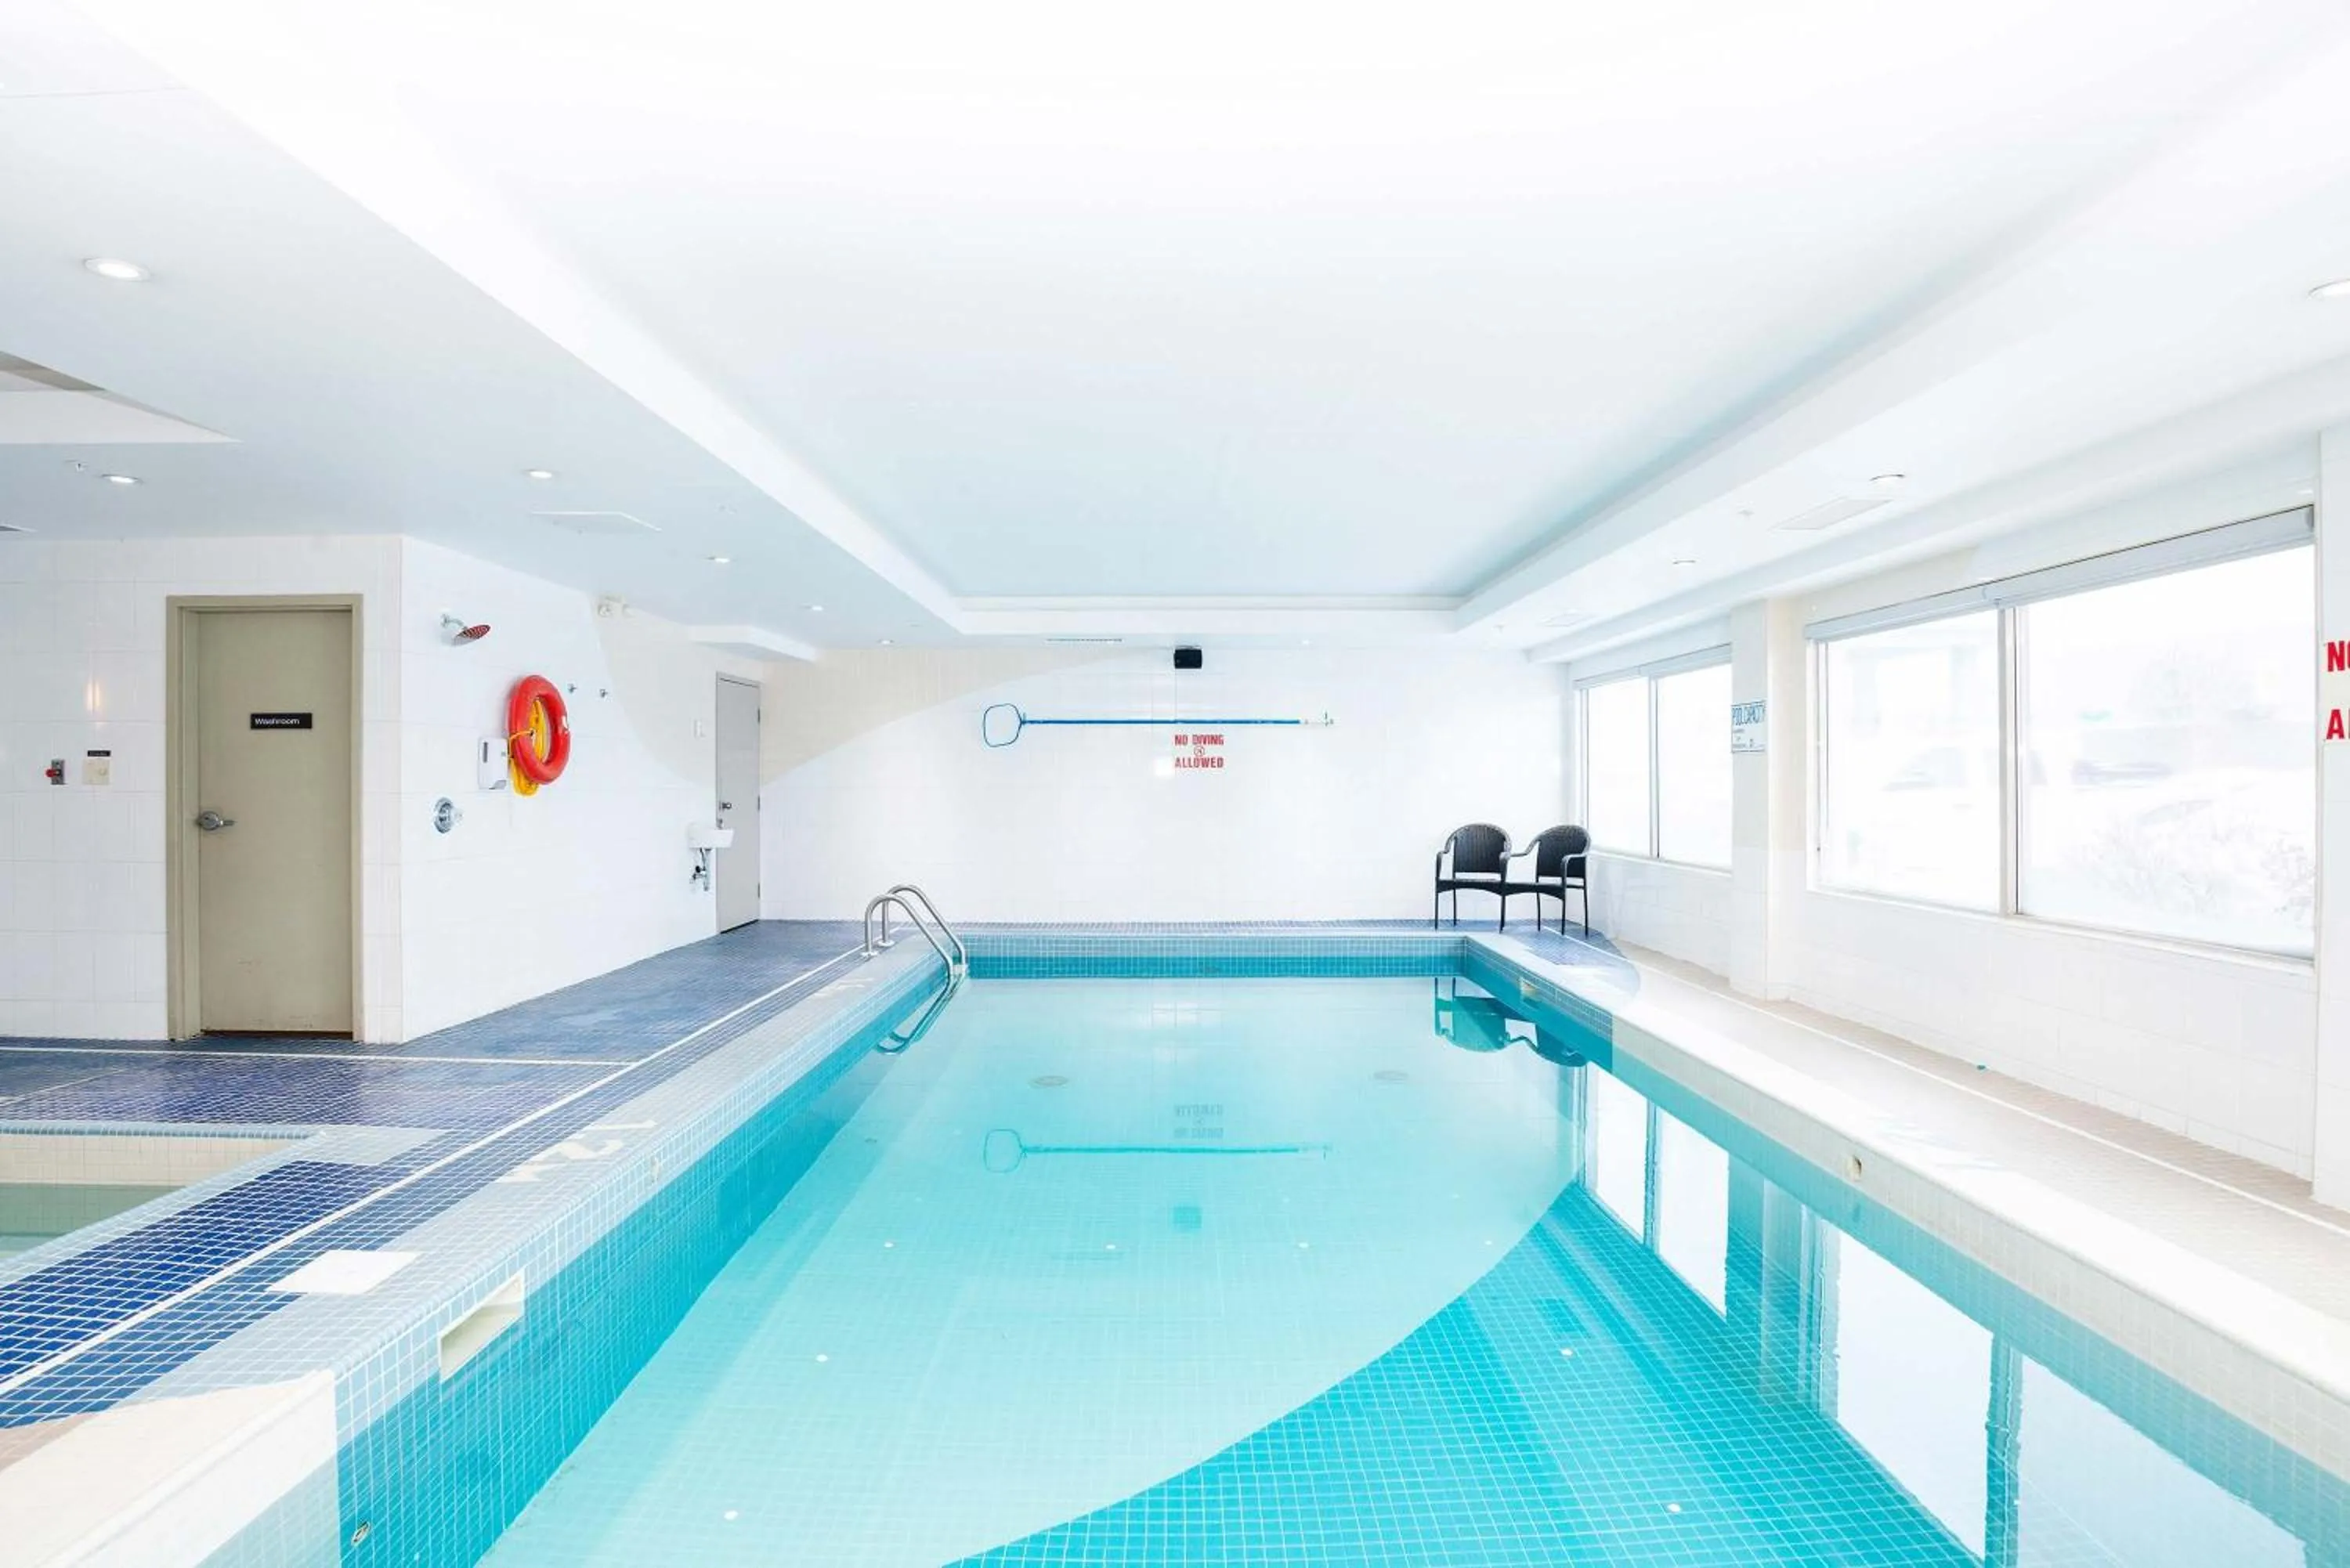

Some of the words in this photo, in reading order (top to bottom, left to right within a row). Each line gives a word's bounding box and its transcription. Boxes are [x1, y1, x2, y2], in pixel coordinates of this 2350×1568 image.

[1174, 734, 1188, 746] NO
[1191, 734, 1224, 746] DIVING
[1174, 757, 1224, 768] ALLOWED
